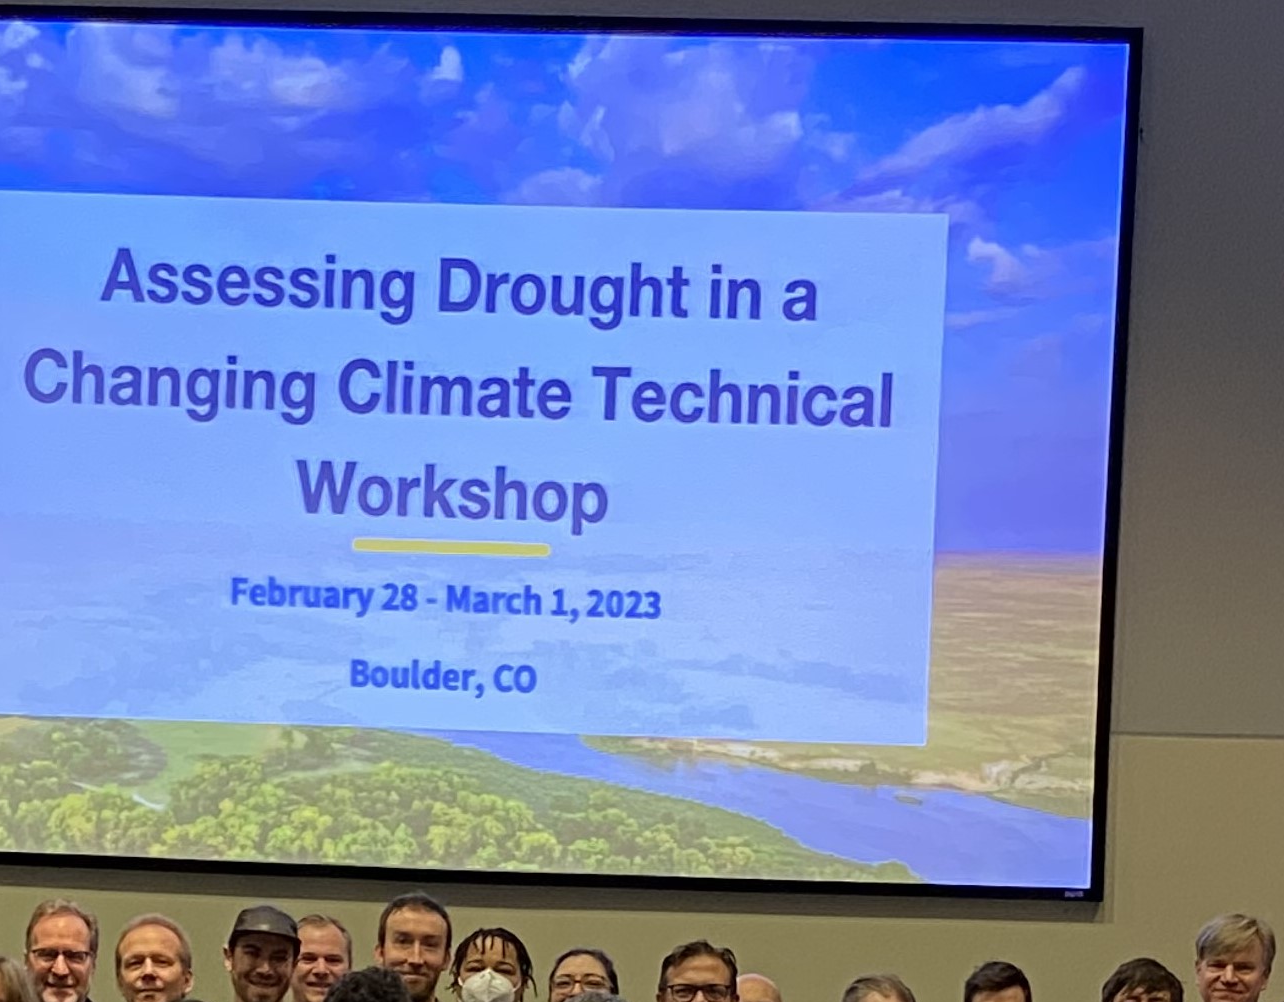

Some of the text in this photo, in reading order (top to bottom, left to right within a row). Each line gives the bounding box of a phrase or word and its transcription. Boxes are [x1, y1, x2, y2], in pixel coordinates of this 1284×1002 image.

[100, 247, 818, 329] Assessing Drought in a
[24, 348, 893, 429] Changing Climate Technical
[296, 459, 609, 536] Workshop
[231, 576, 374, 617] February
[381, 583, 418, 611] 28
[446, 585, 542, 616] March
[550, 589, 579, 623] 1,
[586, 590, 662, 619] 2023
[350, 659, 538, 698] Boulder, CO
